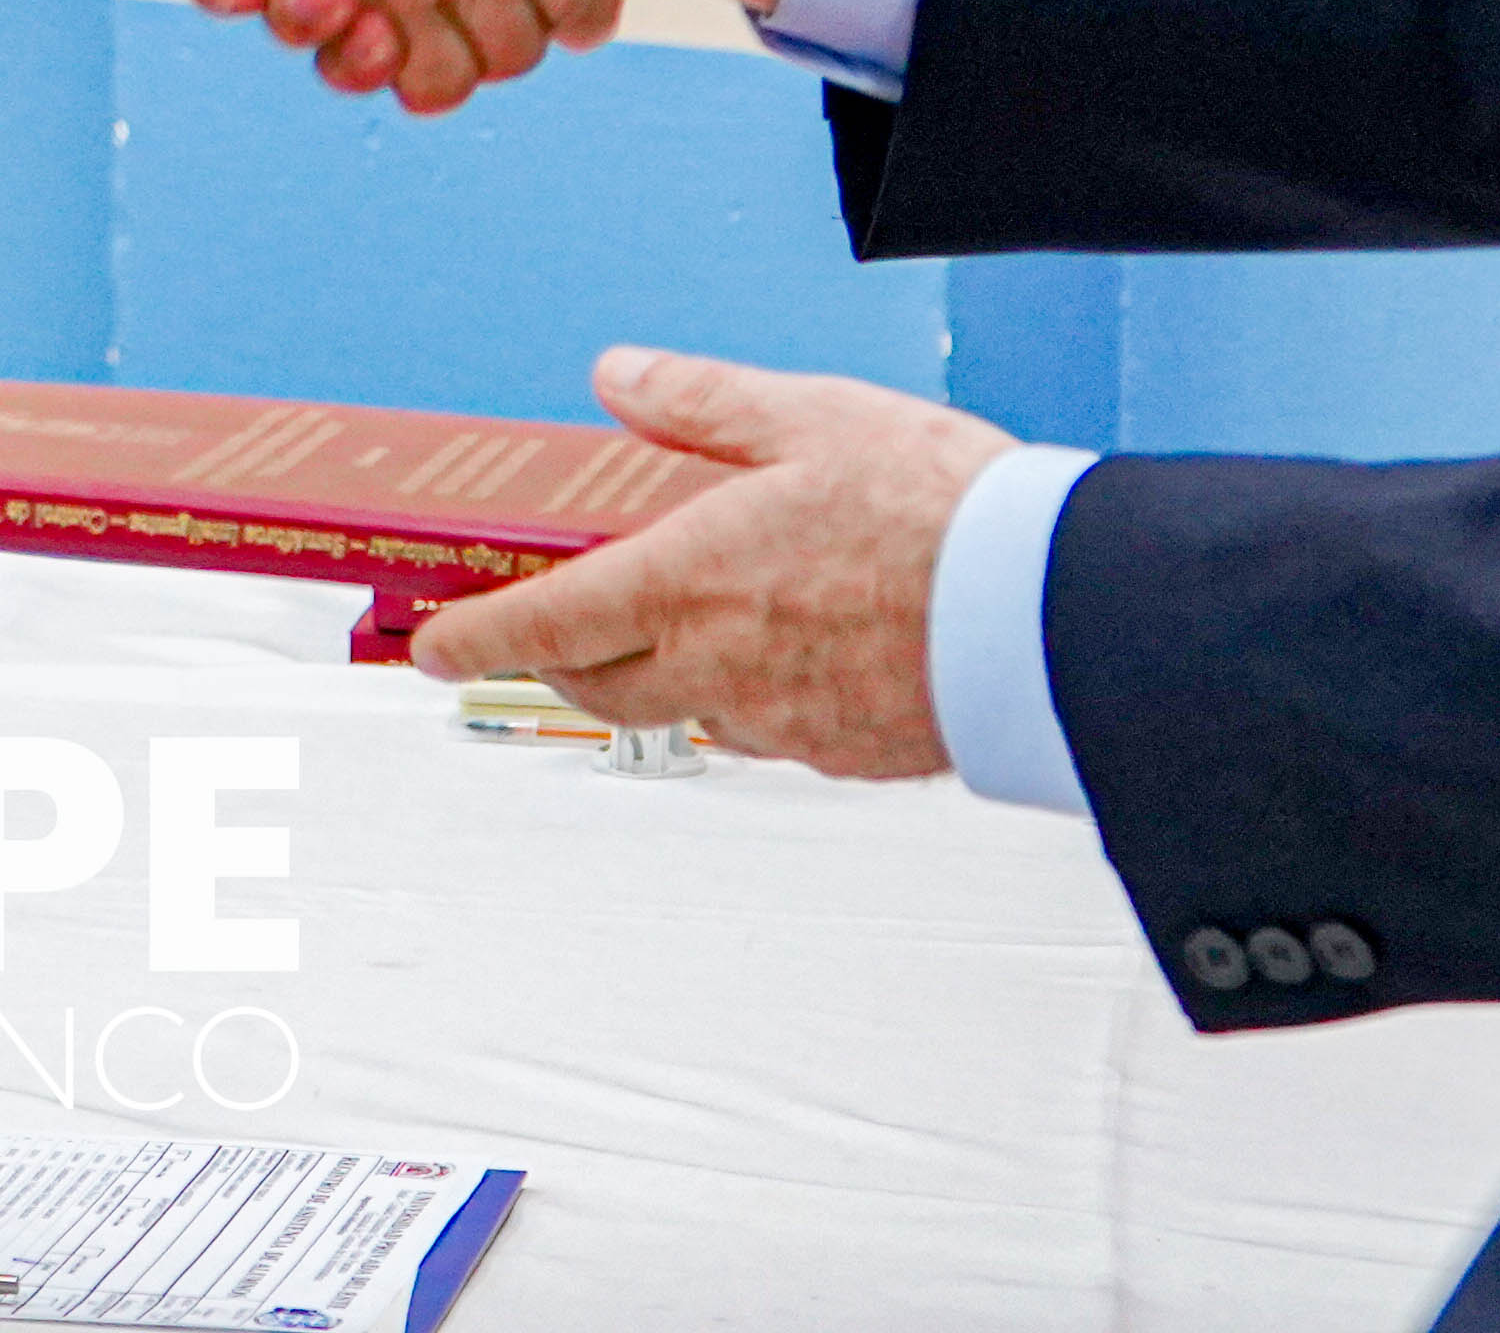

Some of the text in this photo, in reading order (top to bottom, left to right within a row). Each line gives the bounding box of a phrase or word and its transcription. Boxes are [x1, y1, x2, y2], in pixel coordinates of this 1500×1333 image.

[6, 499, 31, 526] de
[34, 502, 108, 535] Control
[315, 1156, 361, 1194] REGISTRO
[306, 1193, 331, 1205] DE
[383, 1191, 436, 1240] UNIVERSIDAD
[269, 1205, 319, 1248] ASISTENCIA
[259, 1251, 284, 1262] DE
[357, 1241, 397, 1274] PRIVADA
[227, 1263, 271, 1299] ALUMNOS
